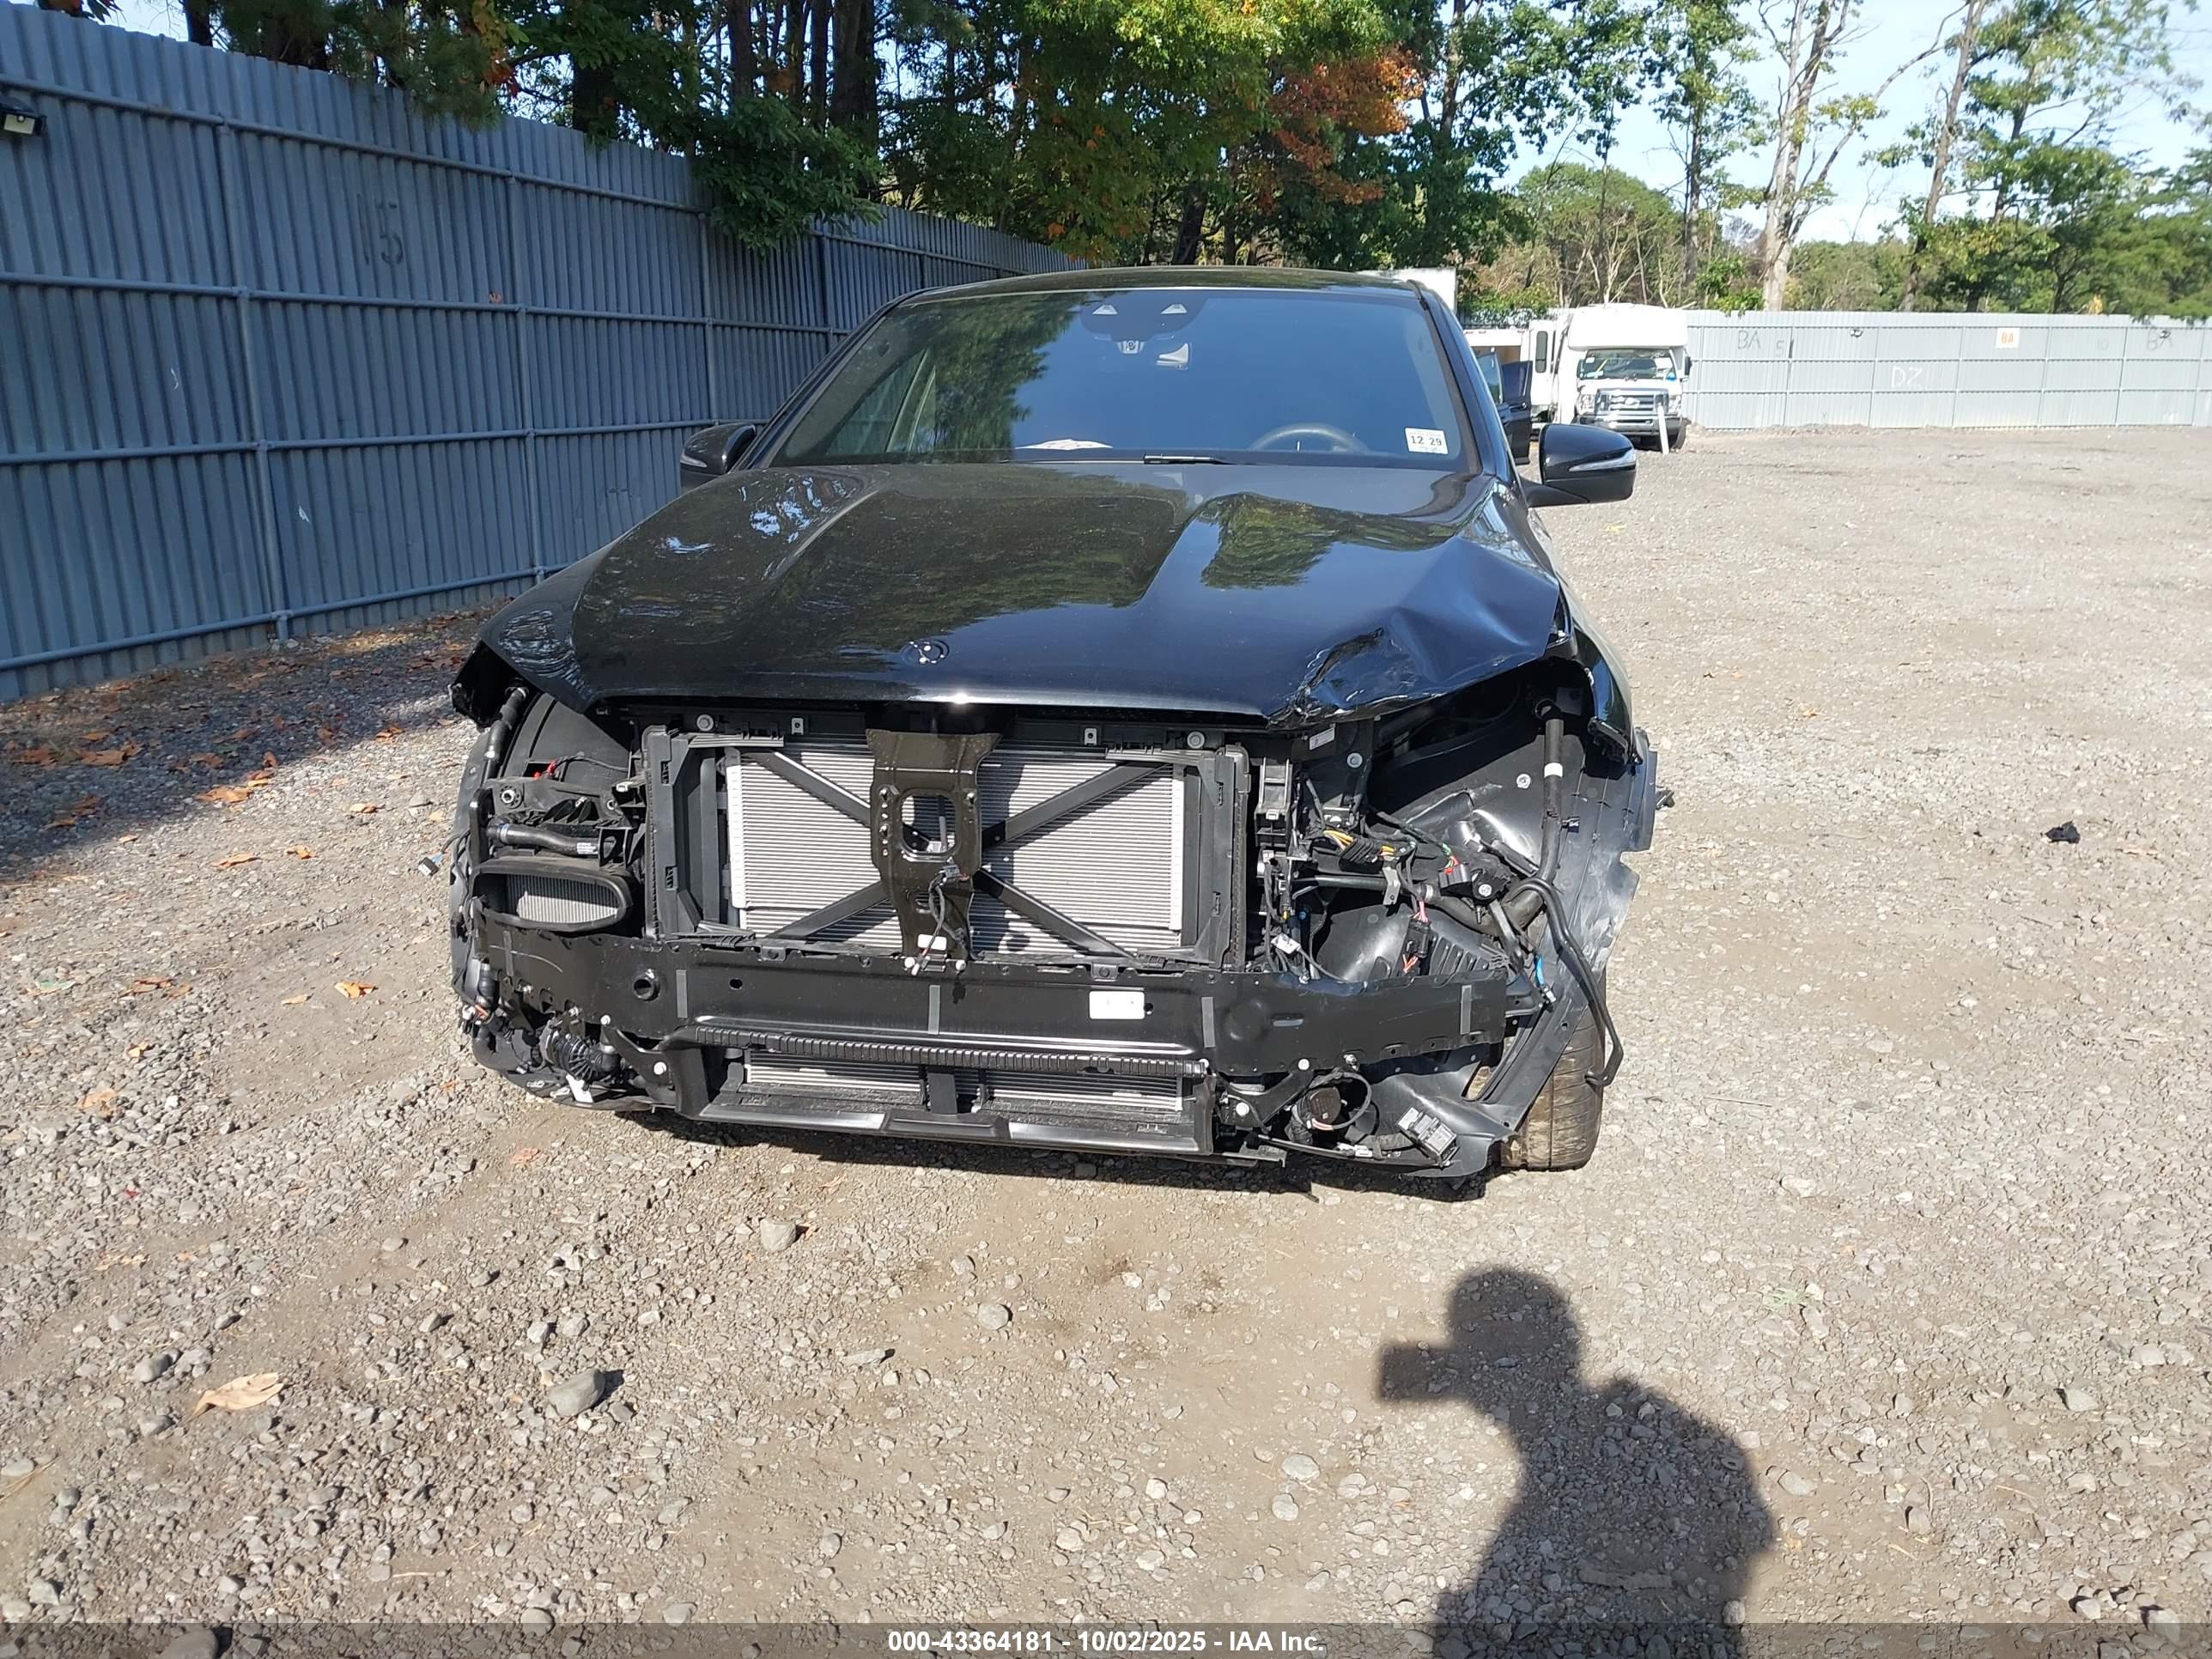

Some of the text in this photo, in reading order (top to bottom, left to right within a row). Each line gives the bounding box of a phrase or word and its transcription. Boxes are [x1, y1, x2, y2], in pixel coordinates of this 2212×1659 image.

[356, 192, 404, 265] 15
[1737, 329, 1761, 349] BA
[1410, 434, 1443, 447] 12 29
